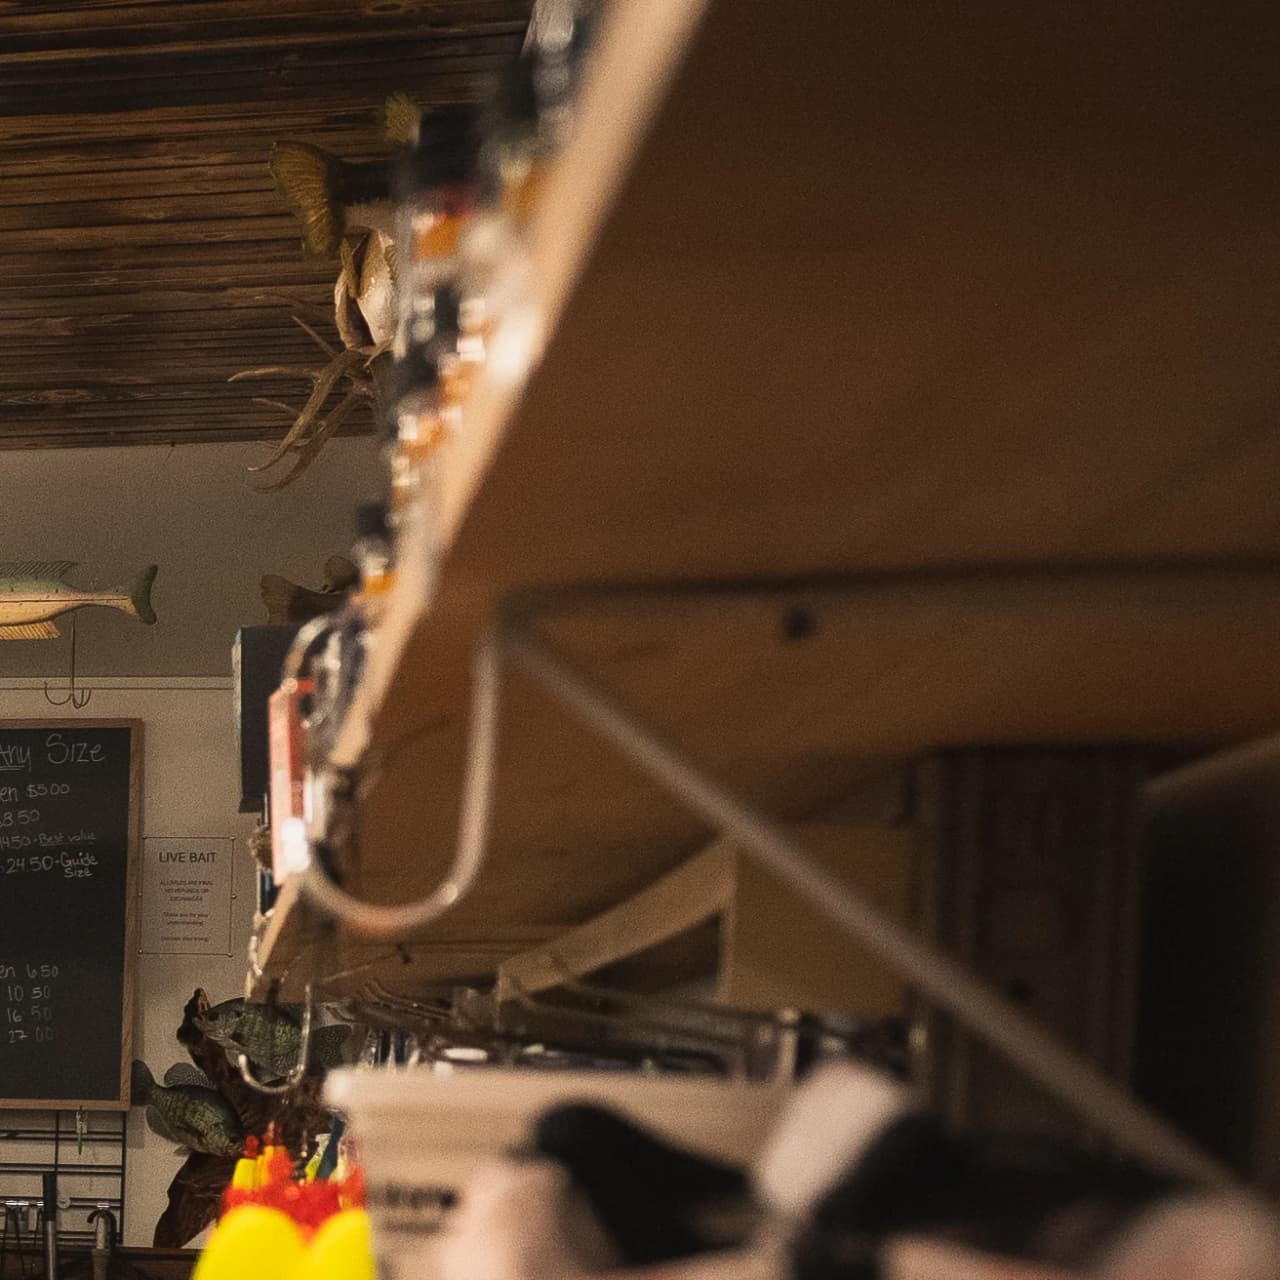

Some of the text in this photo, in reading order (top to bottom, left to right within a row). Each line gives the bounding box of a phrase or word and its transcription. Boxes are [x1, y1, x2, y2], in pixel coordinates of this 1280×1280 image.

[45, 733, 106, 765] Size
[158, 852, 217, 863] LIVE BAIT
